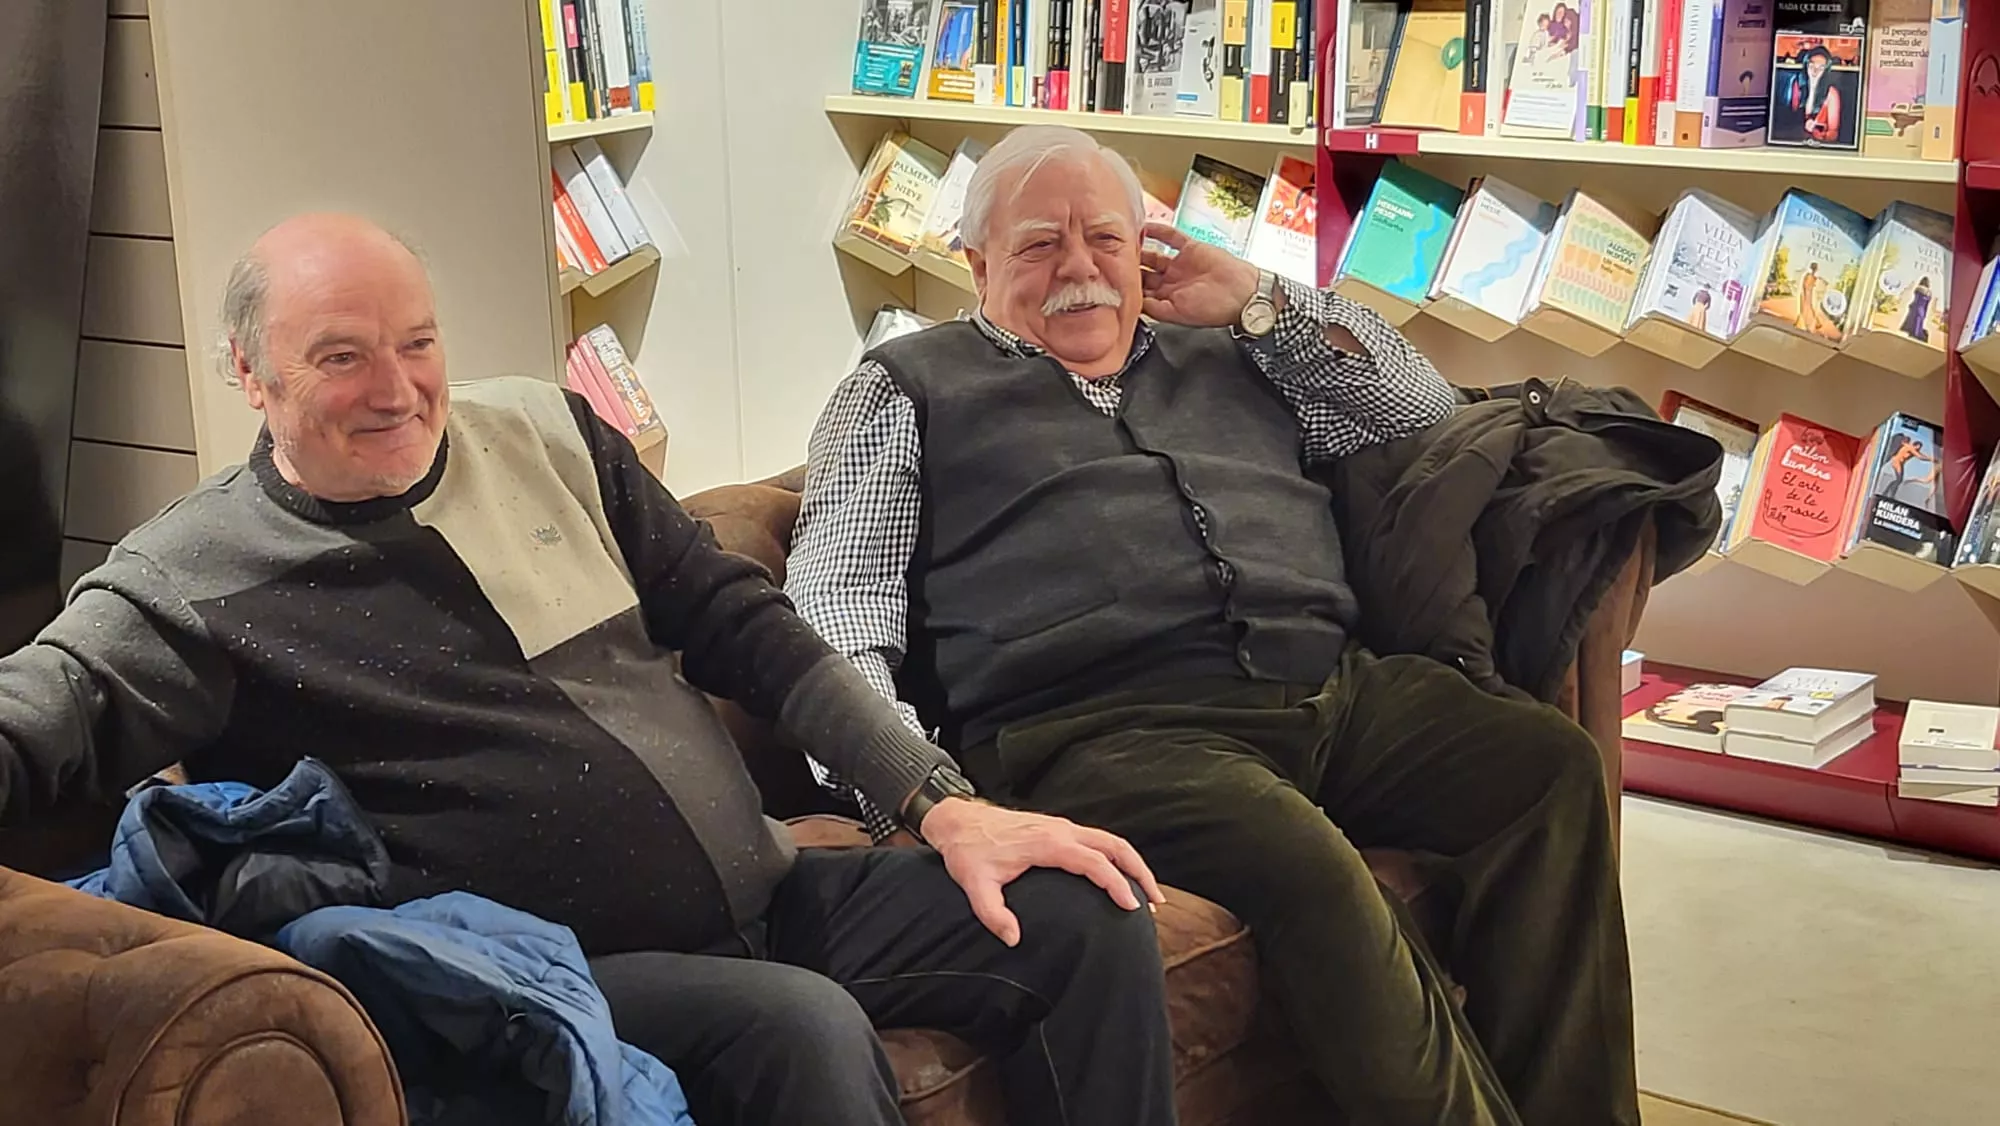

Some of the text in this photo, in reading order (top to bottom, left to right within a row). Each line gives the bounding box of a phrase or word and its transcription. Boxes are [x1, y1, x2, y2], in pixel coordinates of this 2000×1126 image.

[1778, 2, 1842, 13] NADA QUE DECIR
[1882, 26, 1928, 38] El pequeño
[1881, 38, 1922, 47] estudio de
[1880, 47, 1930, 58] los recuerdo
[1880, 58, 1914, 68] perdidos
[1365, 133, 1378, 149] H
[895, 183, 922, 201] NIEVE
[1374, 207, 1397, 220] HESSE
[1376, 199, 1415, 220] HERMANN
[1704, 222, 1743, 251] VILLA
[1811, 231, 1838, 249] VILLA
[1696, 241, 1739, 269] TELAS
[1790, 444, 1830, 465] milan
[1780, 449, 1832, 481] kundera
[1781, 471, 1825, 494] El arte
[1786, 488, 1818, 507] de la
[1783, 504, 1830, 524] novela
[1877, 500, 1910, 517] MILAN
[1875, 509, 1921, 532] KUNDERA
